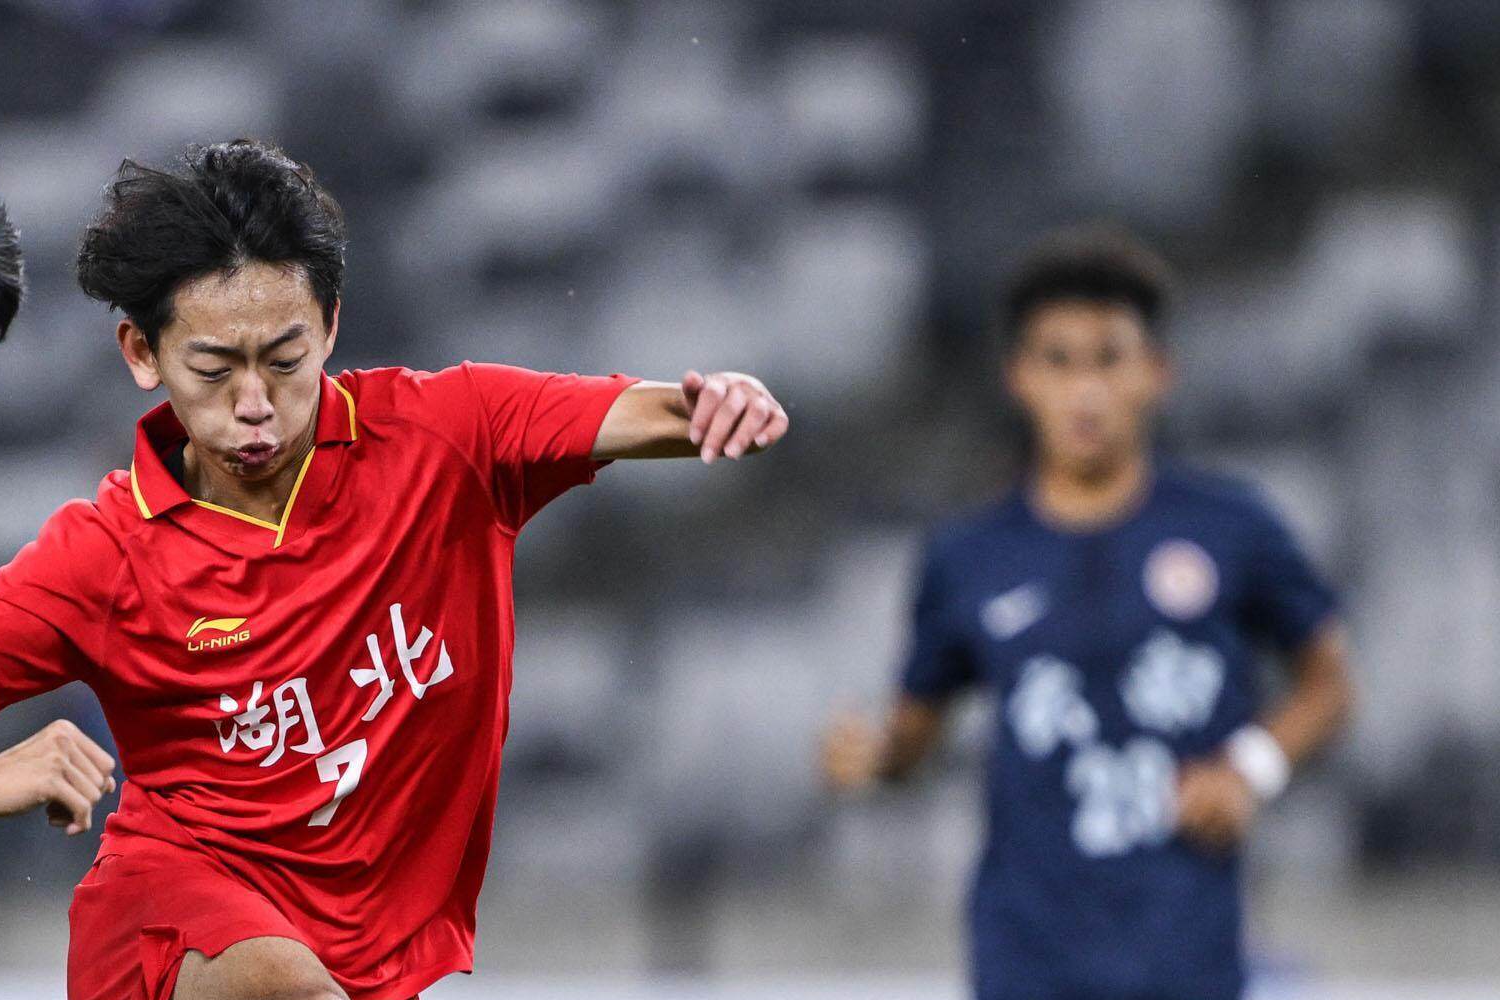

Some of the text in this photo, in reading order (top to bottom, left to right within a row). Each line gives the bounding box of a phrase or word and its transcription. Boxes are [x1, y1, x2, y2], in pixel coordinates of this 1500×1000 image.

[187, 629, 250, 652] LI-NING
[212, 602, 454, 768] 湖北
[307, 737, 368, 827] 7
